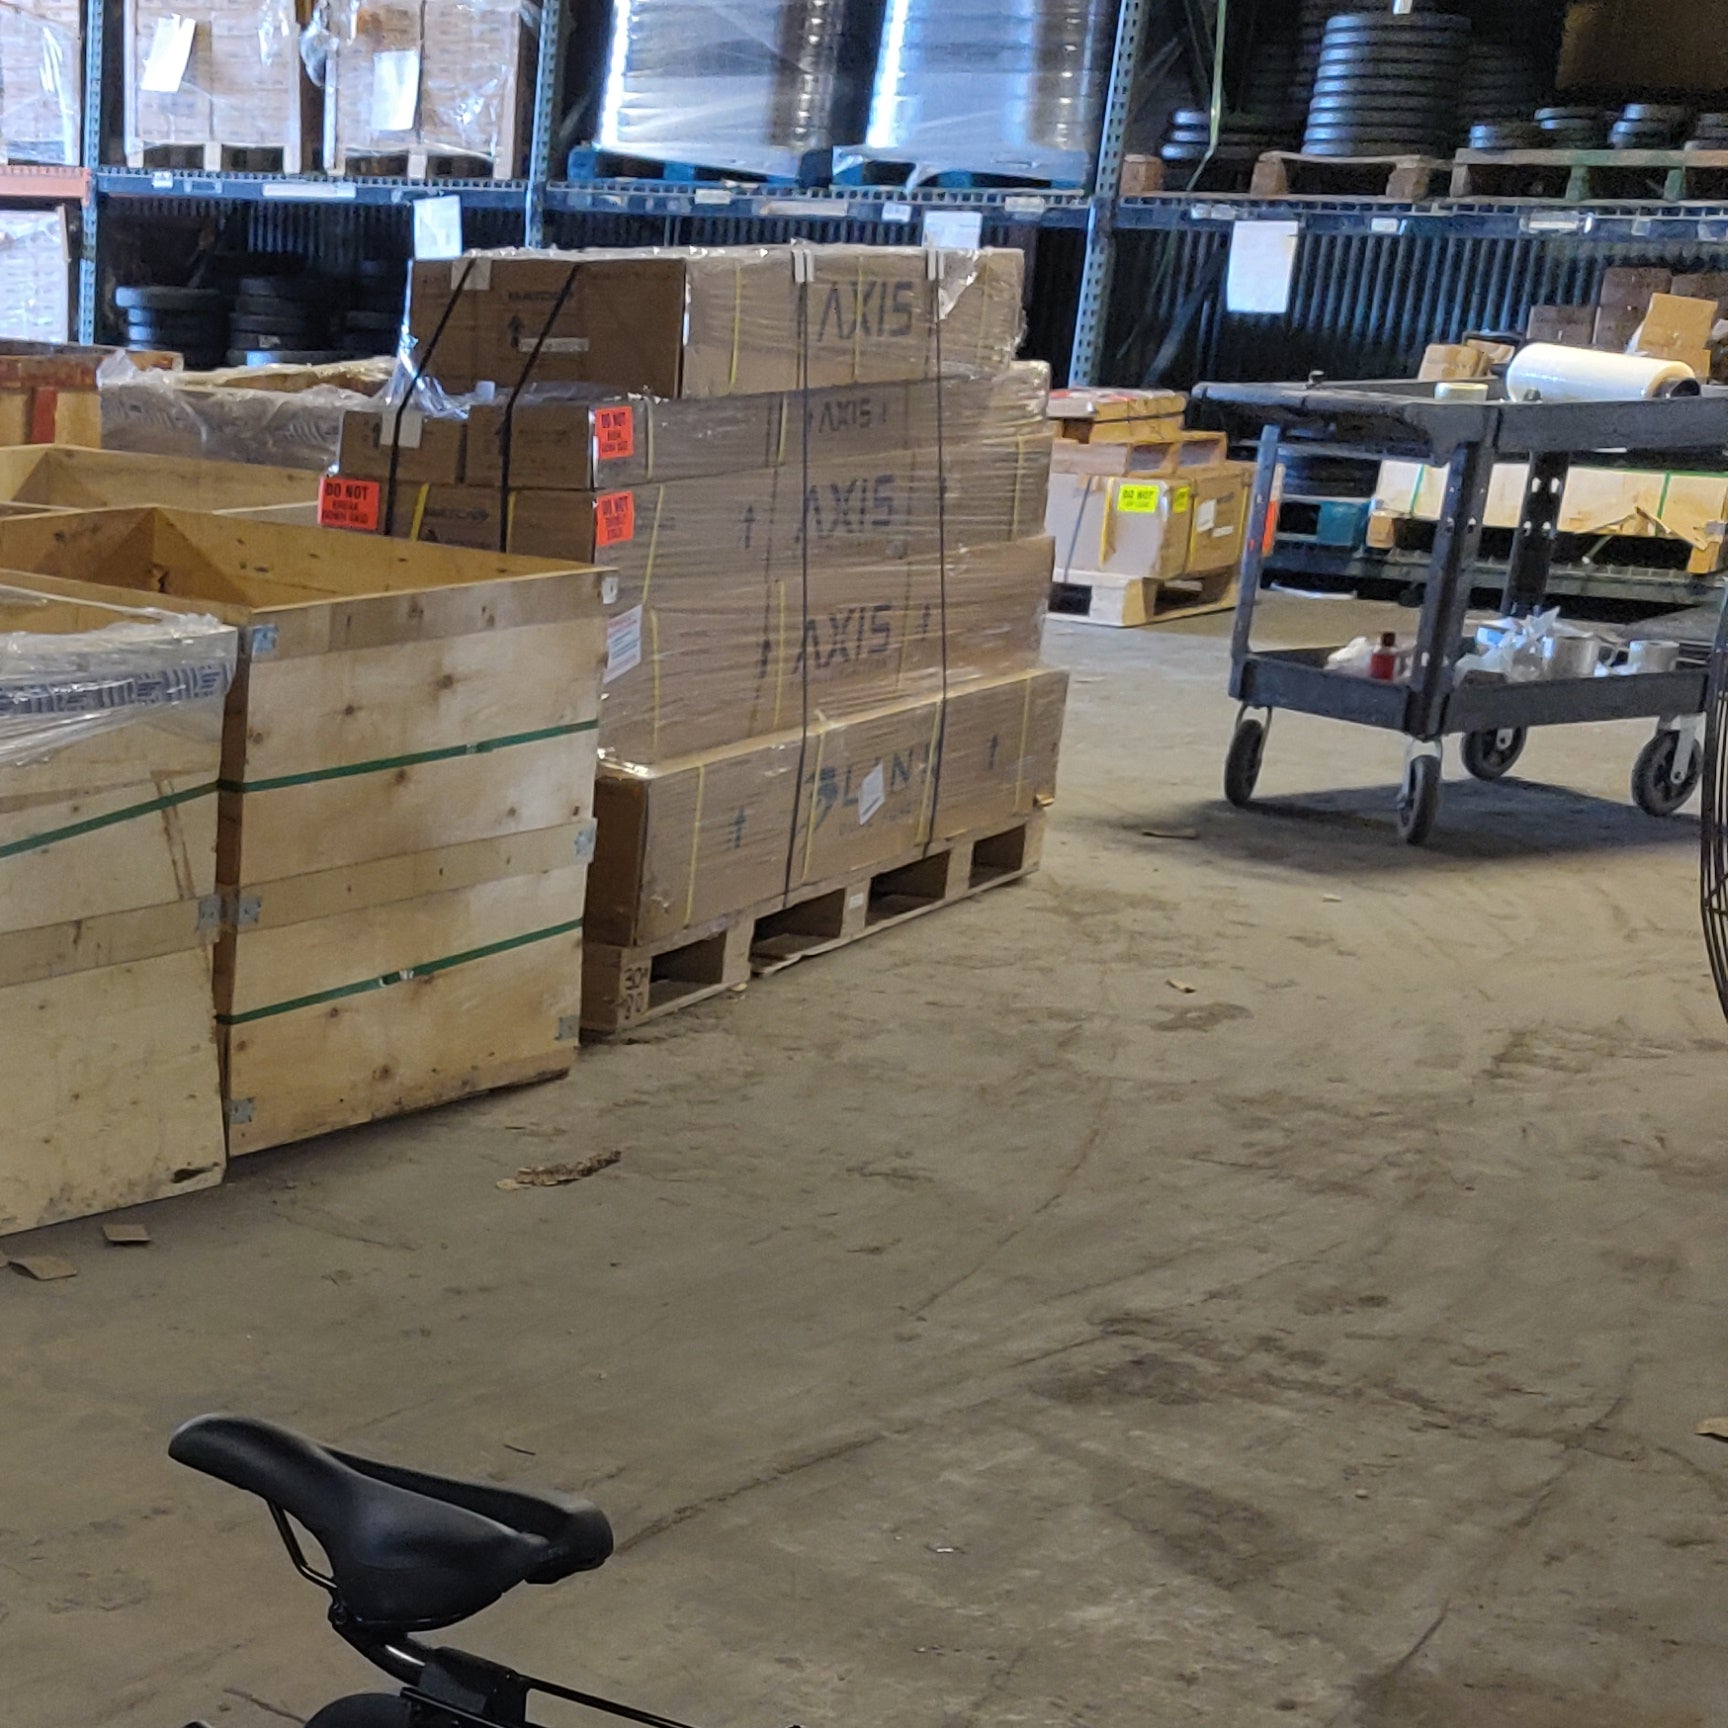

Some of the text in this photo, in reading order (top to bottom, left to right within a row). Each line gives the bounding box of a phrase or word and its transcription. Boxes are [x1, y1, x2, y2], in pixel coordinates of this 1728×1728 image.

[817, 281, 913, 342] AXIS
[326, 482, 369, 501] DO NOT
[793, 474, 895, 544] AXIS
[792, 604, 892, 666] AXIS
